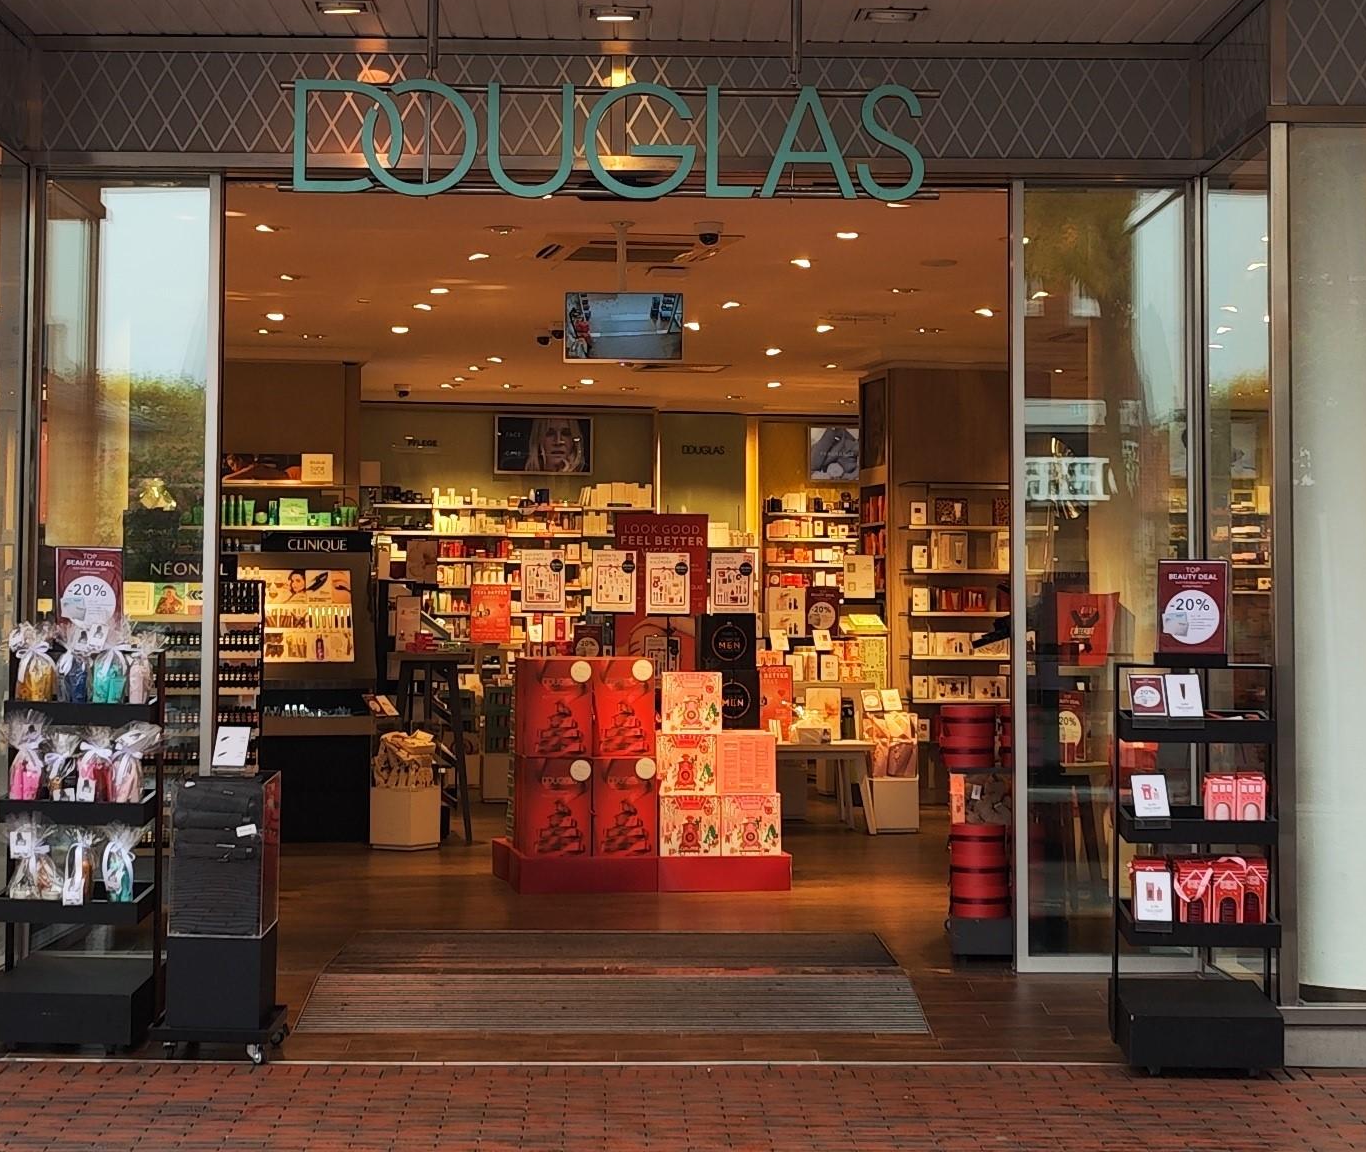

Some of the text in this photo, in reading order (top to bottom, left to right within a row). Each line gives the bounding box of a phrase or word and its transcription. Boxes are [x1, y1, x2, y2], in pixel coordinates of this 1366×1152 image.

[292, 78, 925, 201] DOUGLAS
[681, 445, 725, 455] DOUGLAS
[624, 524, 700, 535] LOOK GOOD
[287, 538, 348, 552] CLINIQUE
[620, 535, 704, 546] FEEL BETTER
[66, 559, 93, 567] BEAUTY
[150, 560, 229, 576] NÉONL
[1168, 573, 1218, 581] BEAUTY DEAL
[68, 583, 107, 596] -20%
[1170, 599, 1210, 611] -20%
[1059, 716, 1077, 726] 20%
